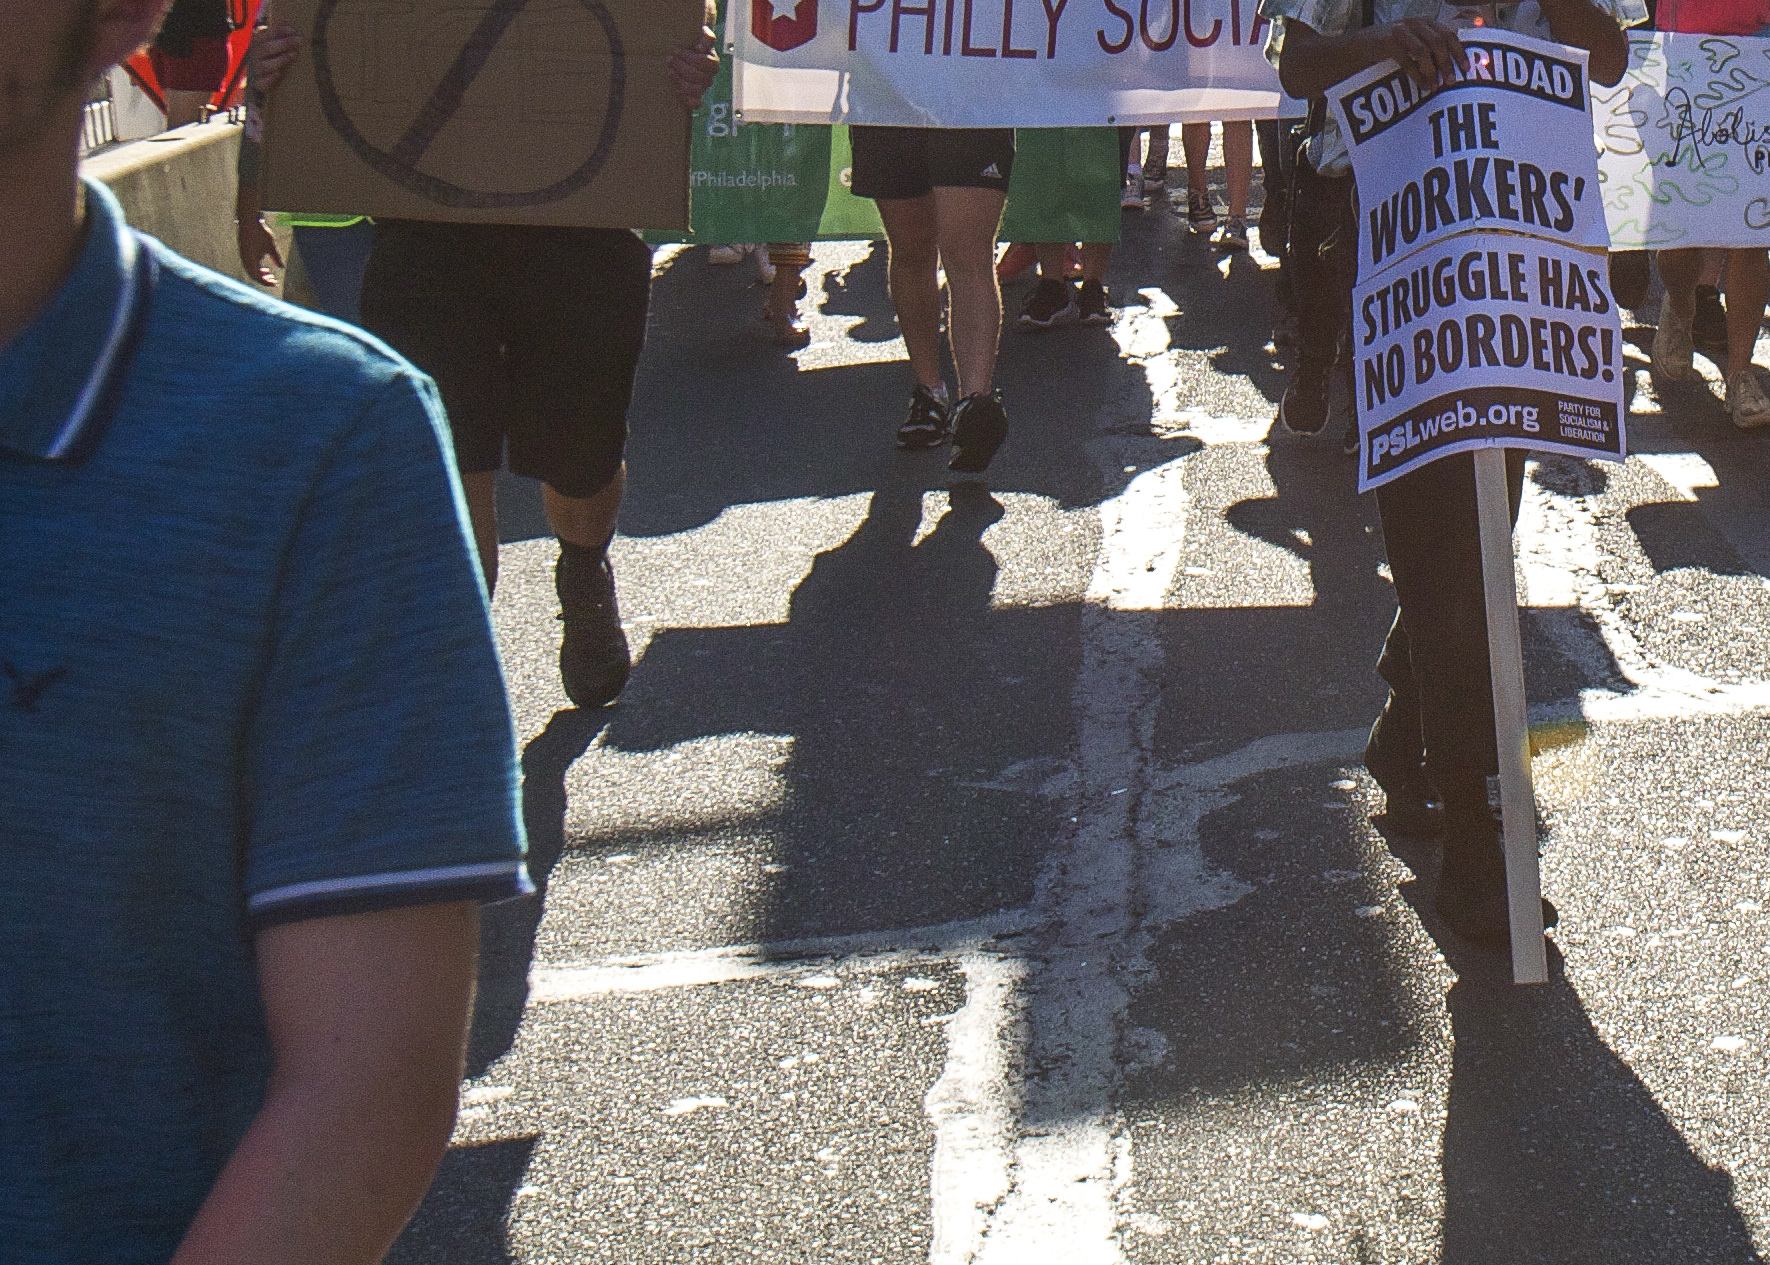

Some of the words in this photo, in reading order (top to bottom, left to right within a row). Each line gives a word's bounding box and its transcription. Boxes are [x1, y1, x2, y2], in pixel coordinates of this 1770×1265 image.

[1428, 102, 1498, 160] THE
[1369, 154, 1586, 266] WORKERS'
[1360, 250, 1529, 346] STRUGGLE
[1538, 255, 1611, 314] HAS
[1364, 342, 1406, 411] NO
[1413, 313, 1615, 384] BORDERS!
[1371, 399, 1541, 466] PSLweb.org
[1558, 413, 1602, 431] SOCIALISM
